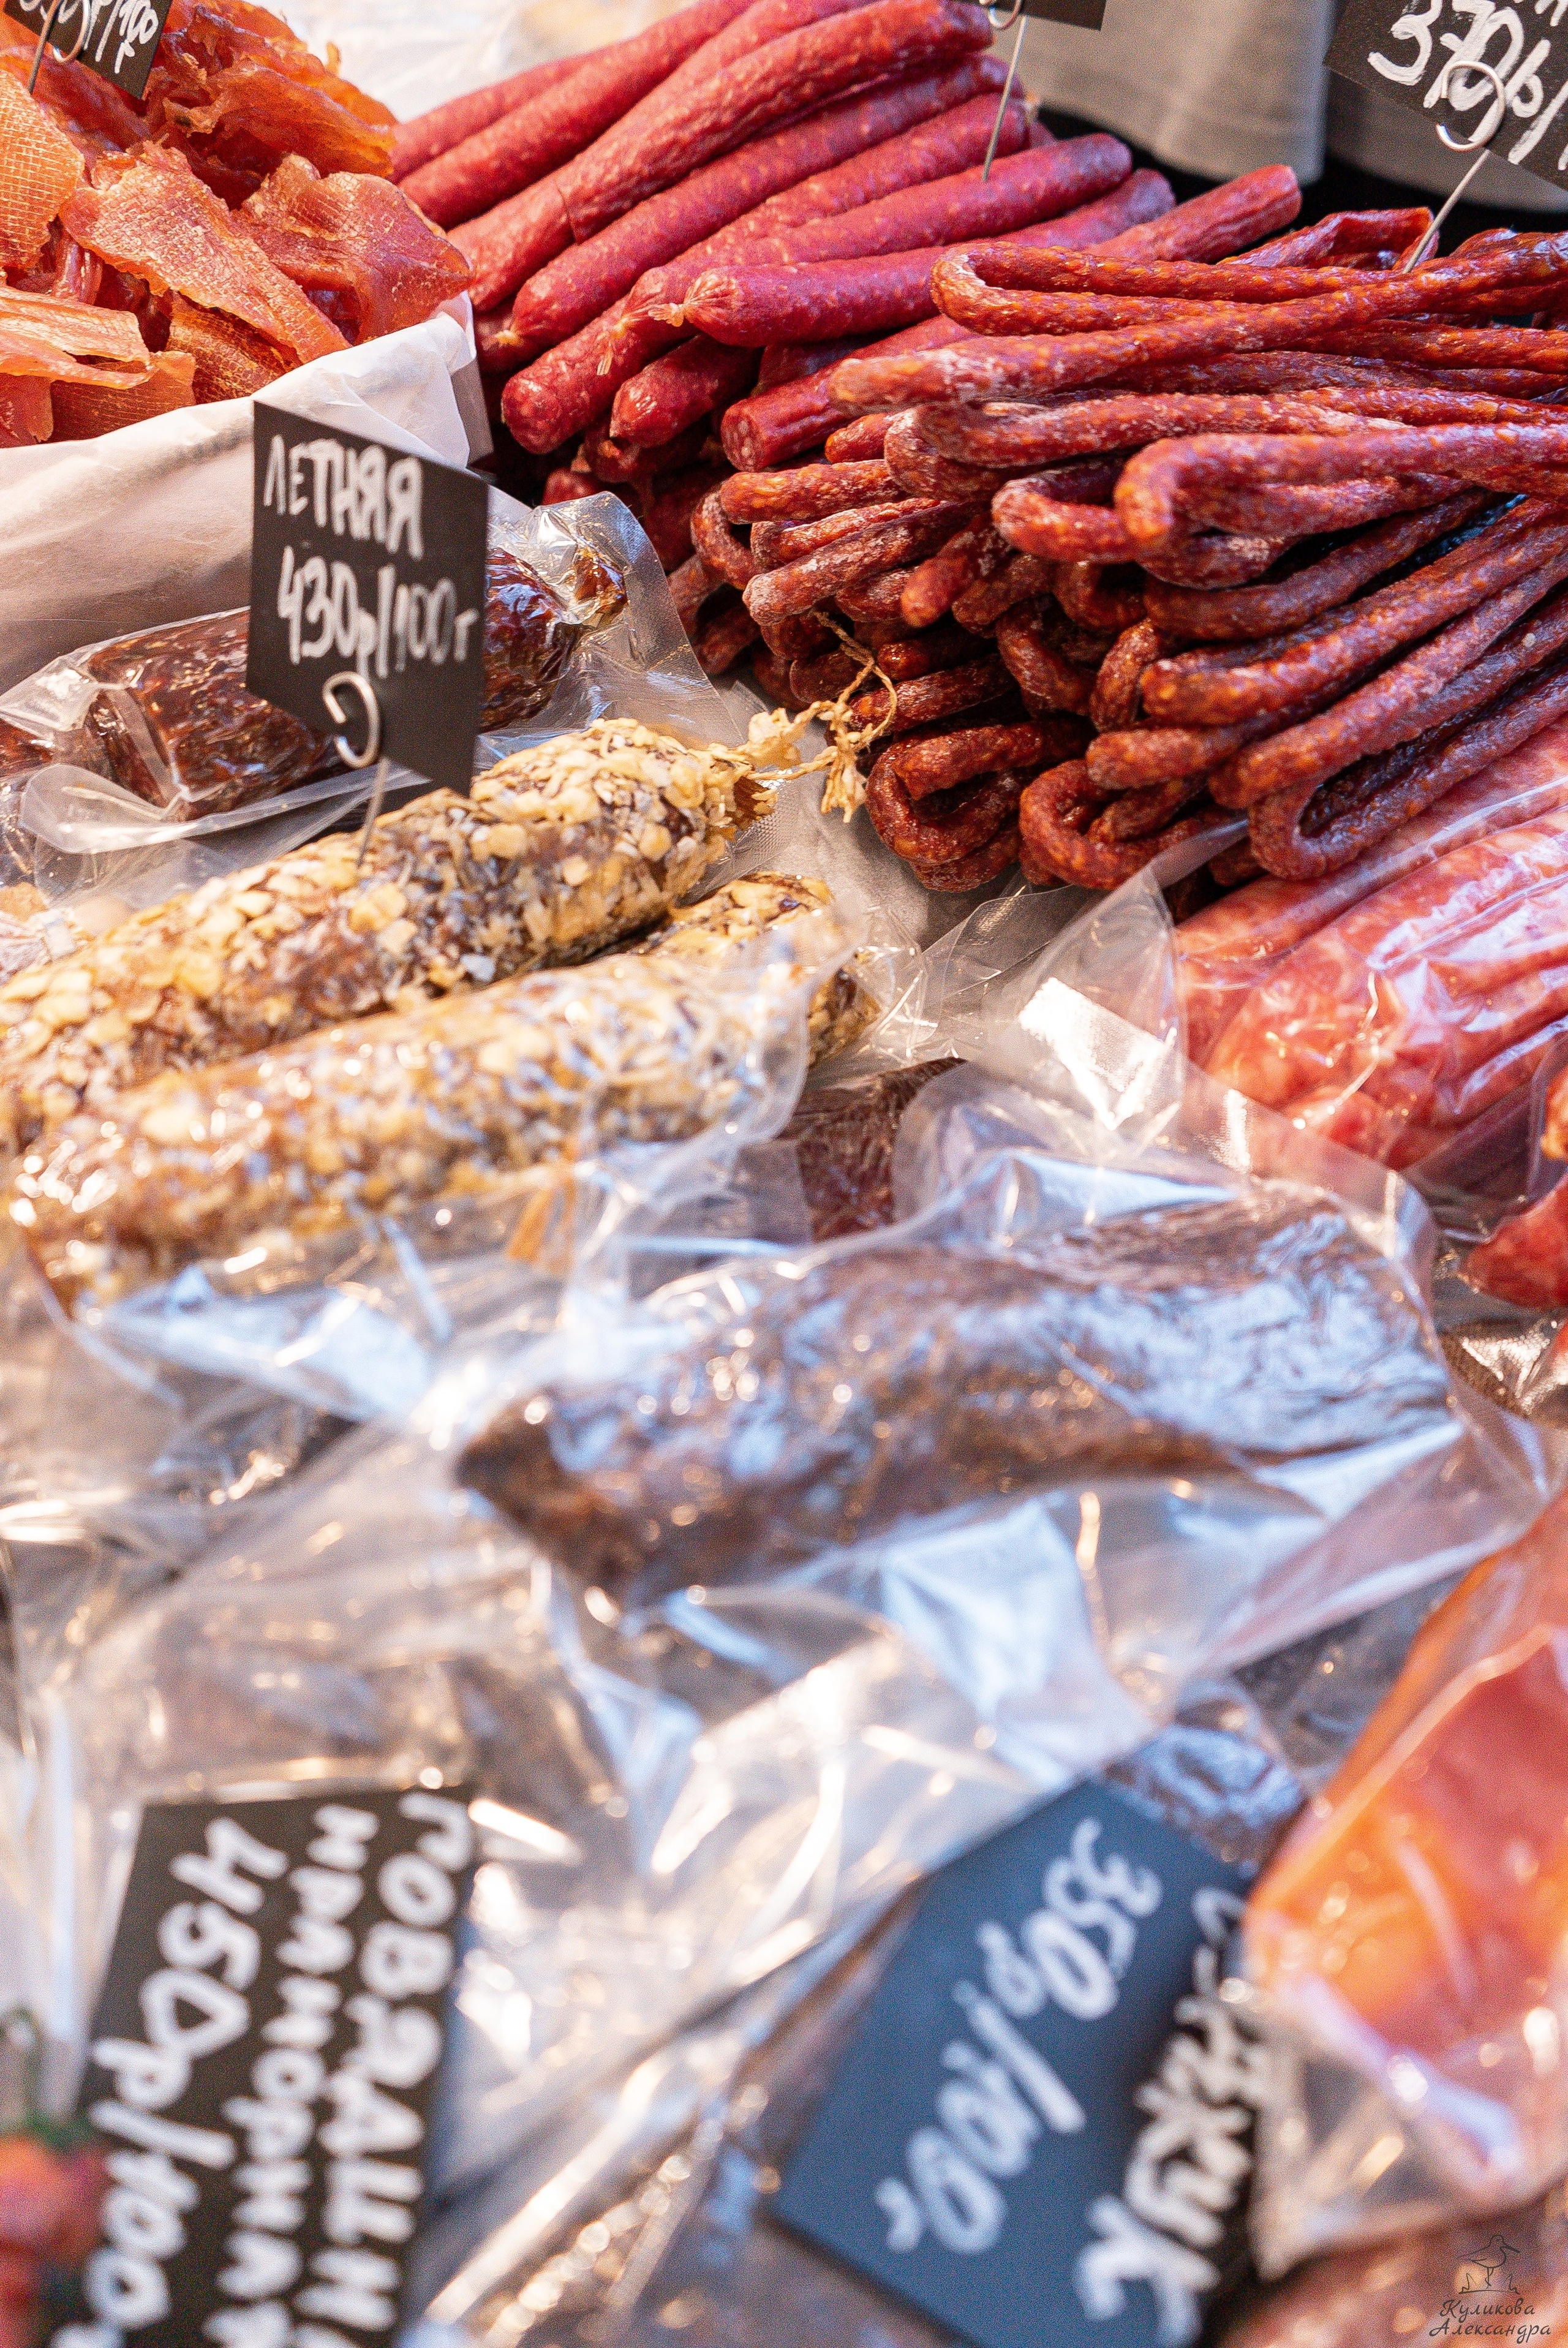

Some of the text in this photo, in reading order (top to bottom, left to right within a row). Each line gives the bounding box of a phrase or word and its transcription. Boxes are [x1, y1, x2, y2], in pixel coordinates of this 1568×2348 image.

[1367, 0, 1568, 170] 370р/
[263, 434, 424, 561] ЛЕТНЯЯ
[276, 546, 479, 679] 430р/100г
[875, 1817, 1163, 2256] 350р/100г
